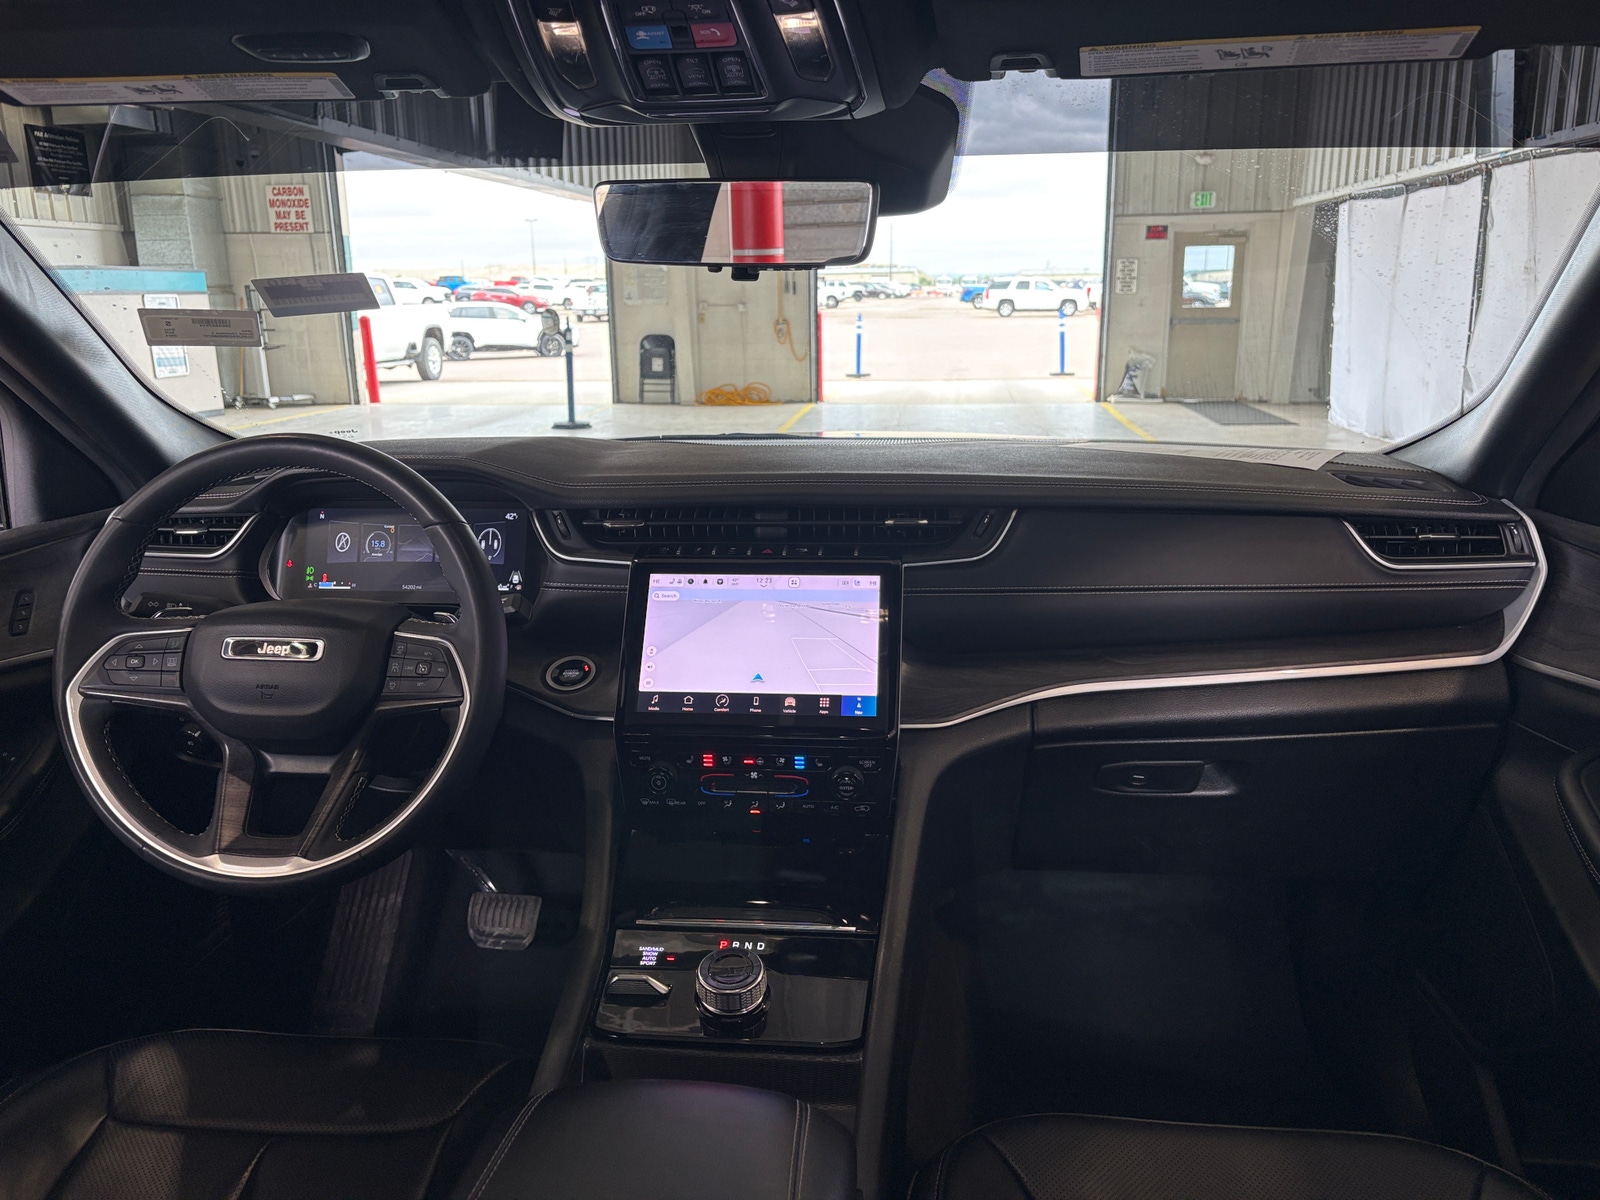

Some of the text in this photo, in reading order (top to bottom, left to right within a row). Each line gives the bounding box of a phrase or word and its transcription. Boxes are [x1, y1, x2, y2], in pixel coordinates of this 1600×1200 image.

[271, 186, 305, 197] CARBON
[268, 198, 310, 208] MONOXIDE
[1193, 191, 1213, 207] EXIT
[274, 210, 306, 220] MAY BE
[274, 222, 309, 231] PRESENT
[371, 540, 386, 548] 15.8
[257, 642, 291, 656] Jeep
[720, 940, 728, 949] P
[744, 942, 753, 950] N
[757, 942, 765, 951] D
